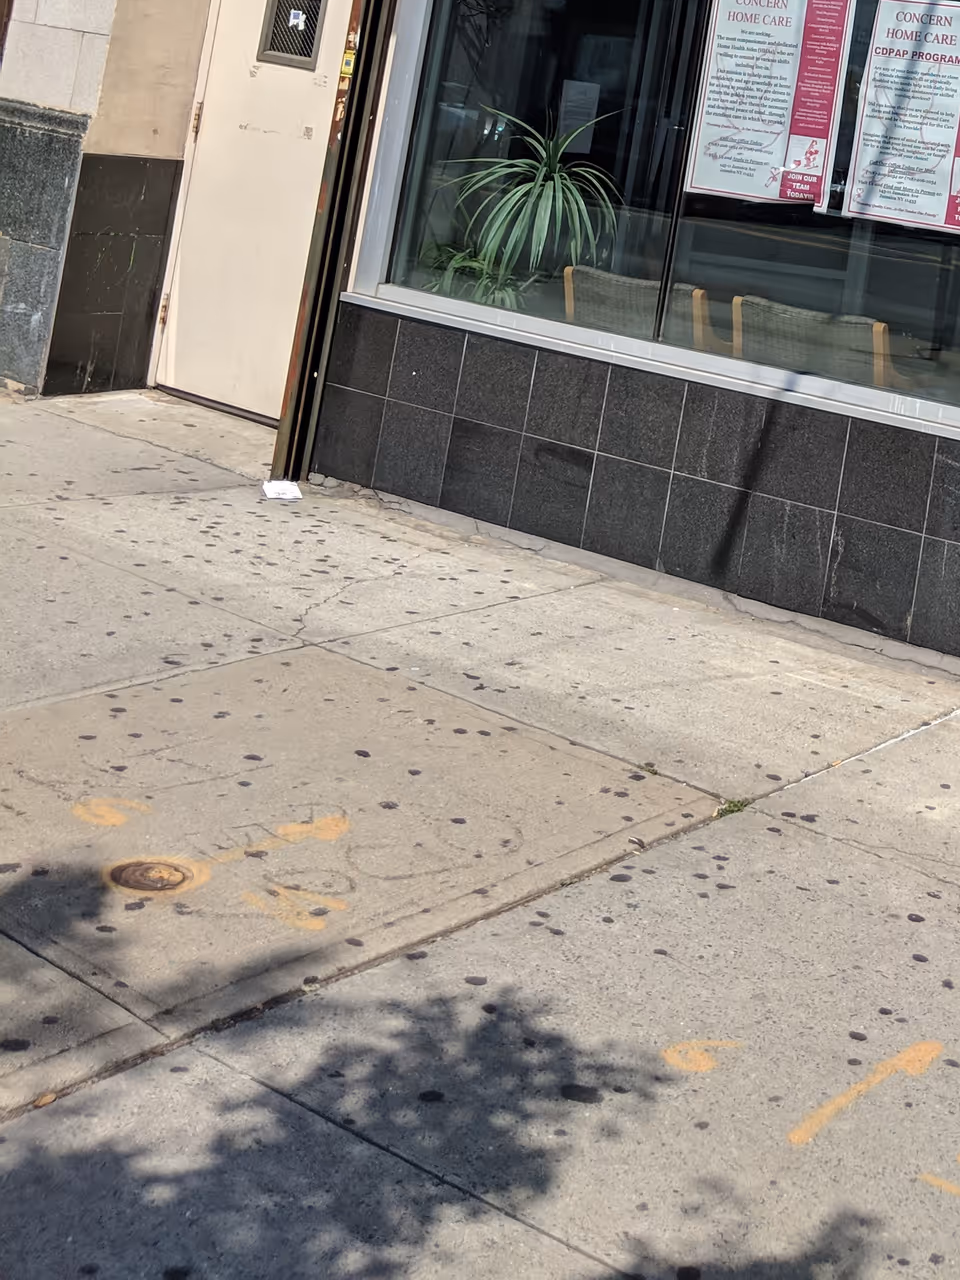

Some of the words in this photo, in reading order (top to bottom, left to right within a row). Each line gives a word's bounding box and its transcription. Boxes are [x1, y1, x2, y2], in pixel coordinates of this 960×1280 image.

[727, 10, 760, 24] HOME
[761, 14, 793, 27] CARE
[894, 10, 953, 27] CONCERN
[885, 27, 921, 42] HOME
[923, 31, 957, 46] CARE
[873, 46, 908, 58] CDPAP
[792, 182, 809, 190] TEAM
